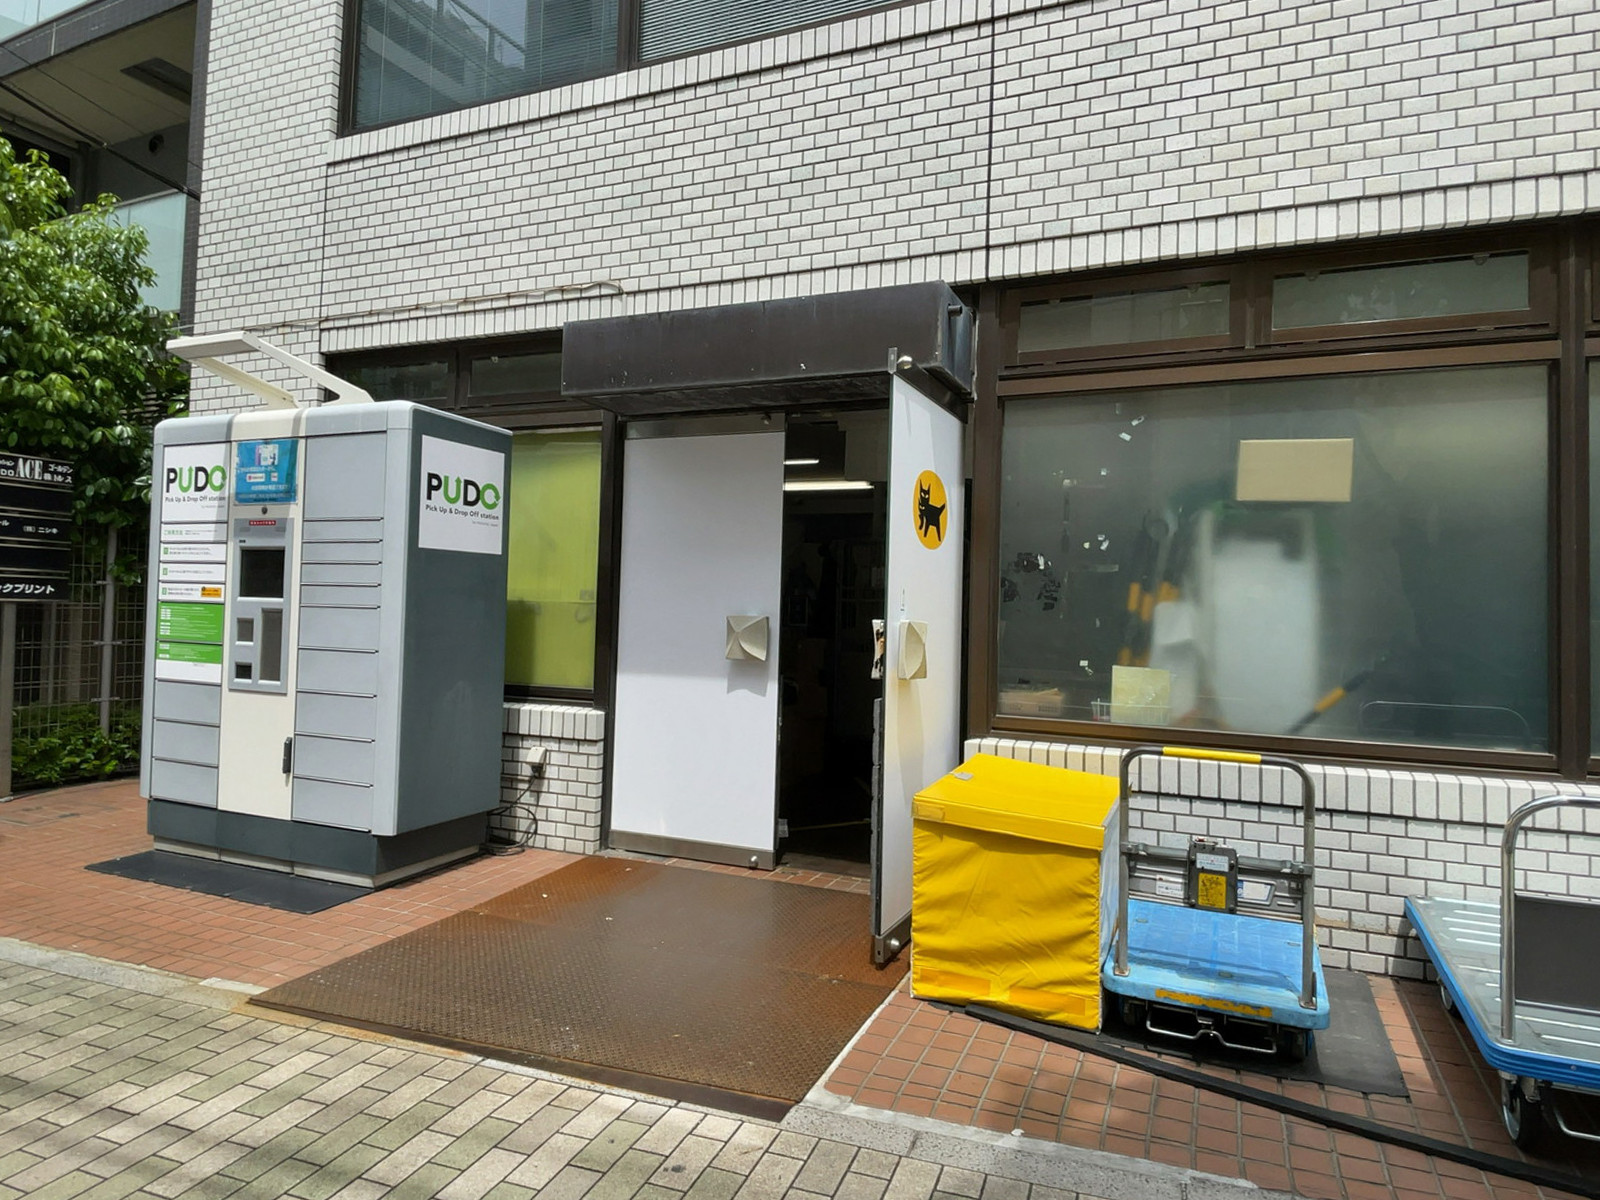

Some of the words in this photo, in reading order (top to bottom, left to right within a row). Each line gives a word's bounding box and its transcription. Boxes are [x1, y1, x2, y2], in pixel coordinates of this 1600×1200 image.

[15, 457, 43, 480] ACE
[166, 465, 227, 493] PUDO
[426, 472, 501, 510] PUDO
[425, 504, 438, 513] Pick
[439, 506, 447, 515] Up
[454, 508, 468, 517] Drop
